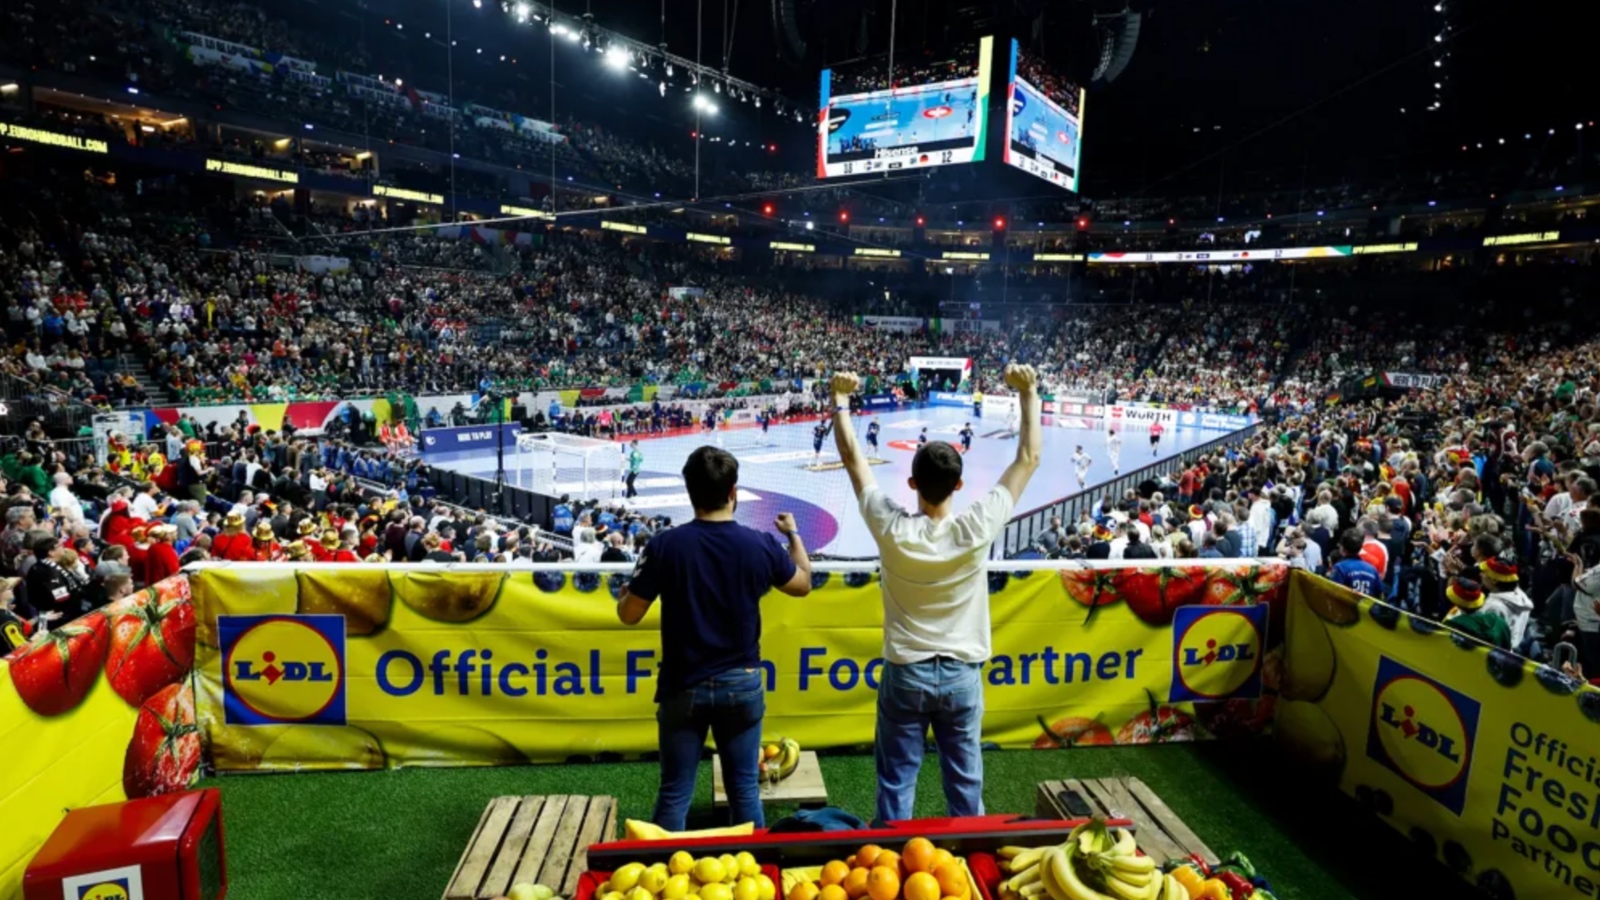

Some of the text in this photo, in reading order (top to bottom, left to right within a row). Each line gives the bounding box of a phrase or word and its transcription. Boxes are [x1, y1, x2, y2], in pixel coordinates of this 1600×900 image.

[375, 648, 605, 697] Official
[797, 647, 886, 691] Foo
[979, 647, 1143, 686] artner
